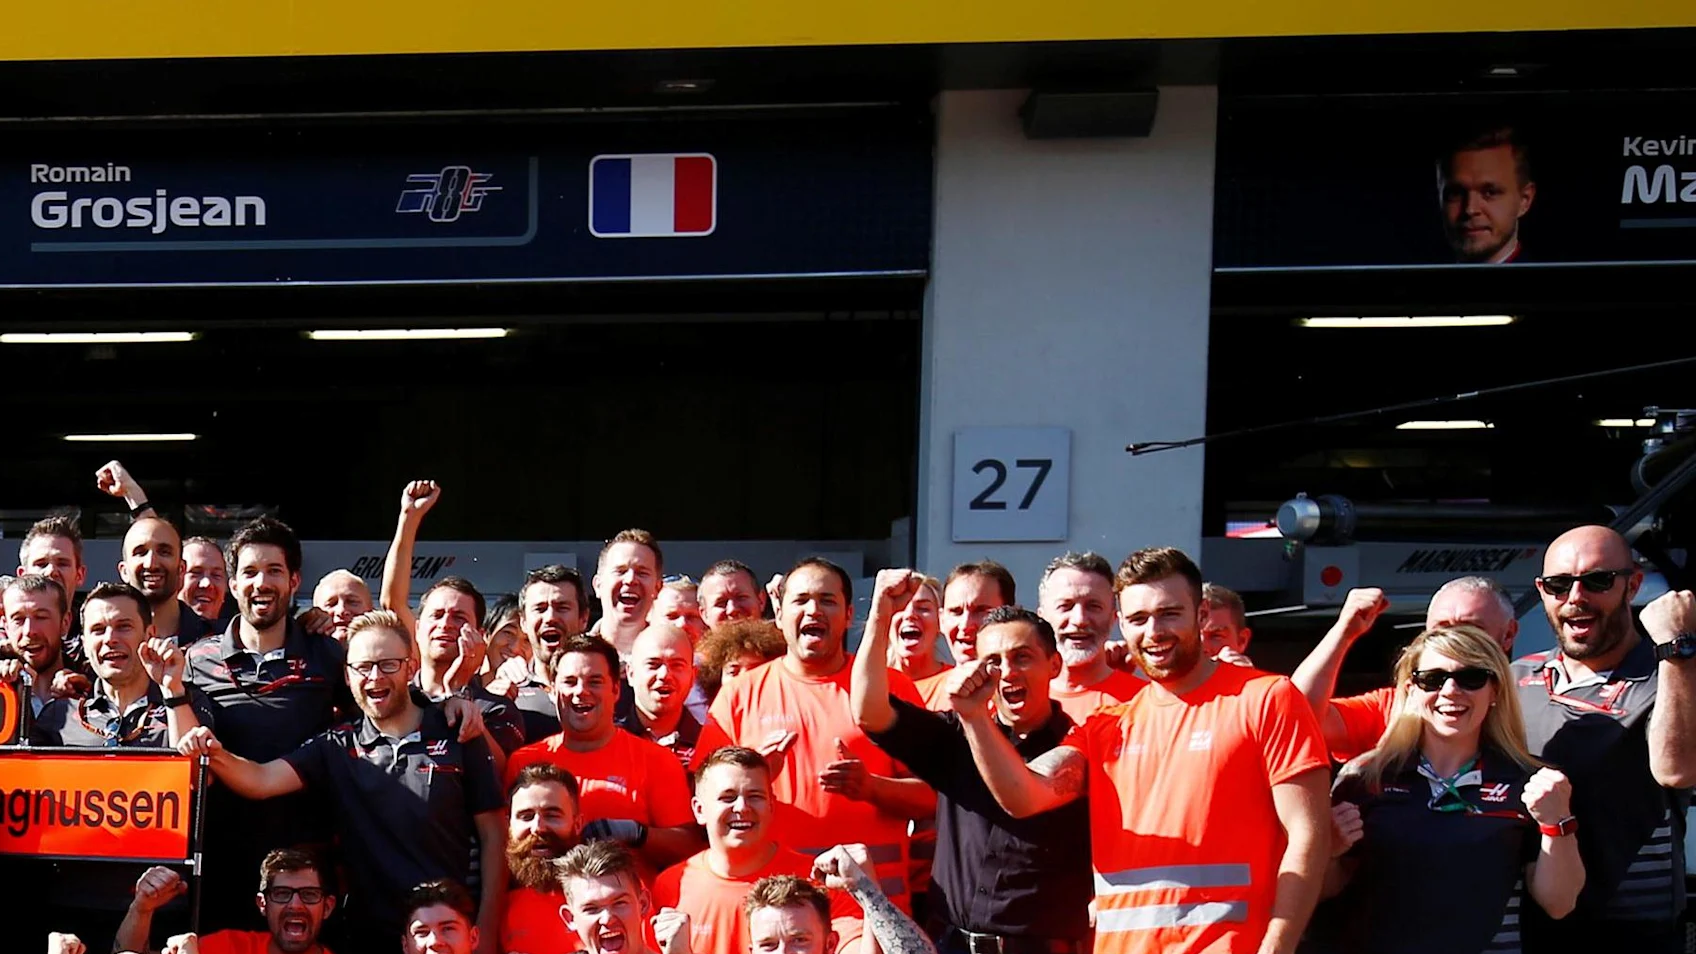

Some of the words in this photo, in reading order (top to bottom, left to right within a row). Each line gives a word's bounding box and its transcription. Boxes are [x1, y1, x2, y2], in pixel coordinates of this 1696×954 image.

[30, 162, 132, 183] Romain
[30, 188, 266, 234] Grosjean
[969, 458, 1053, 510] 27
[351, 556, 446, 579] GROEAN
